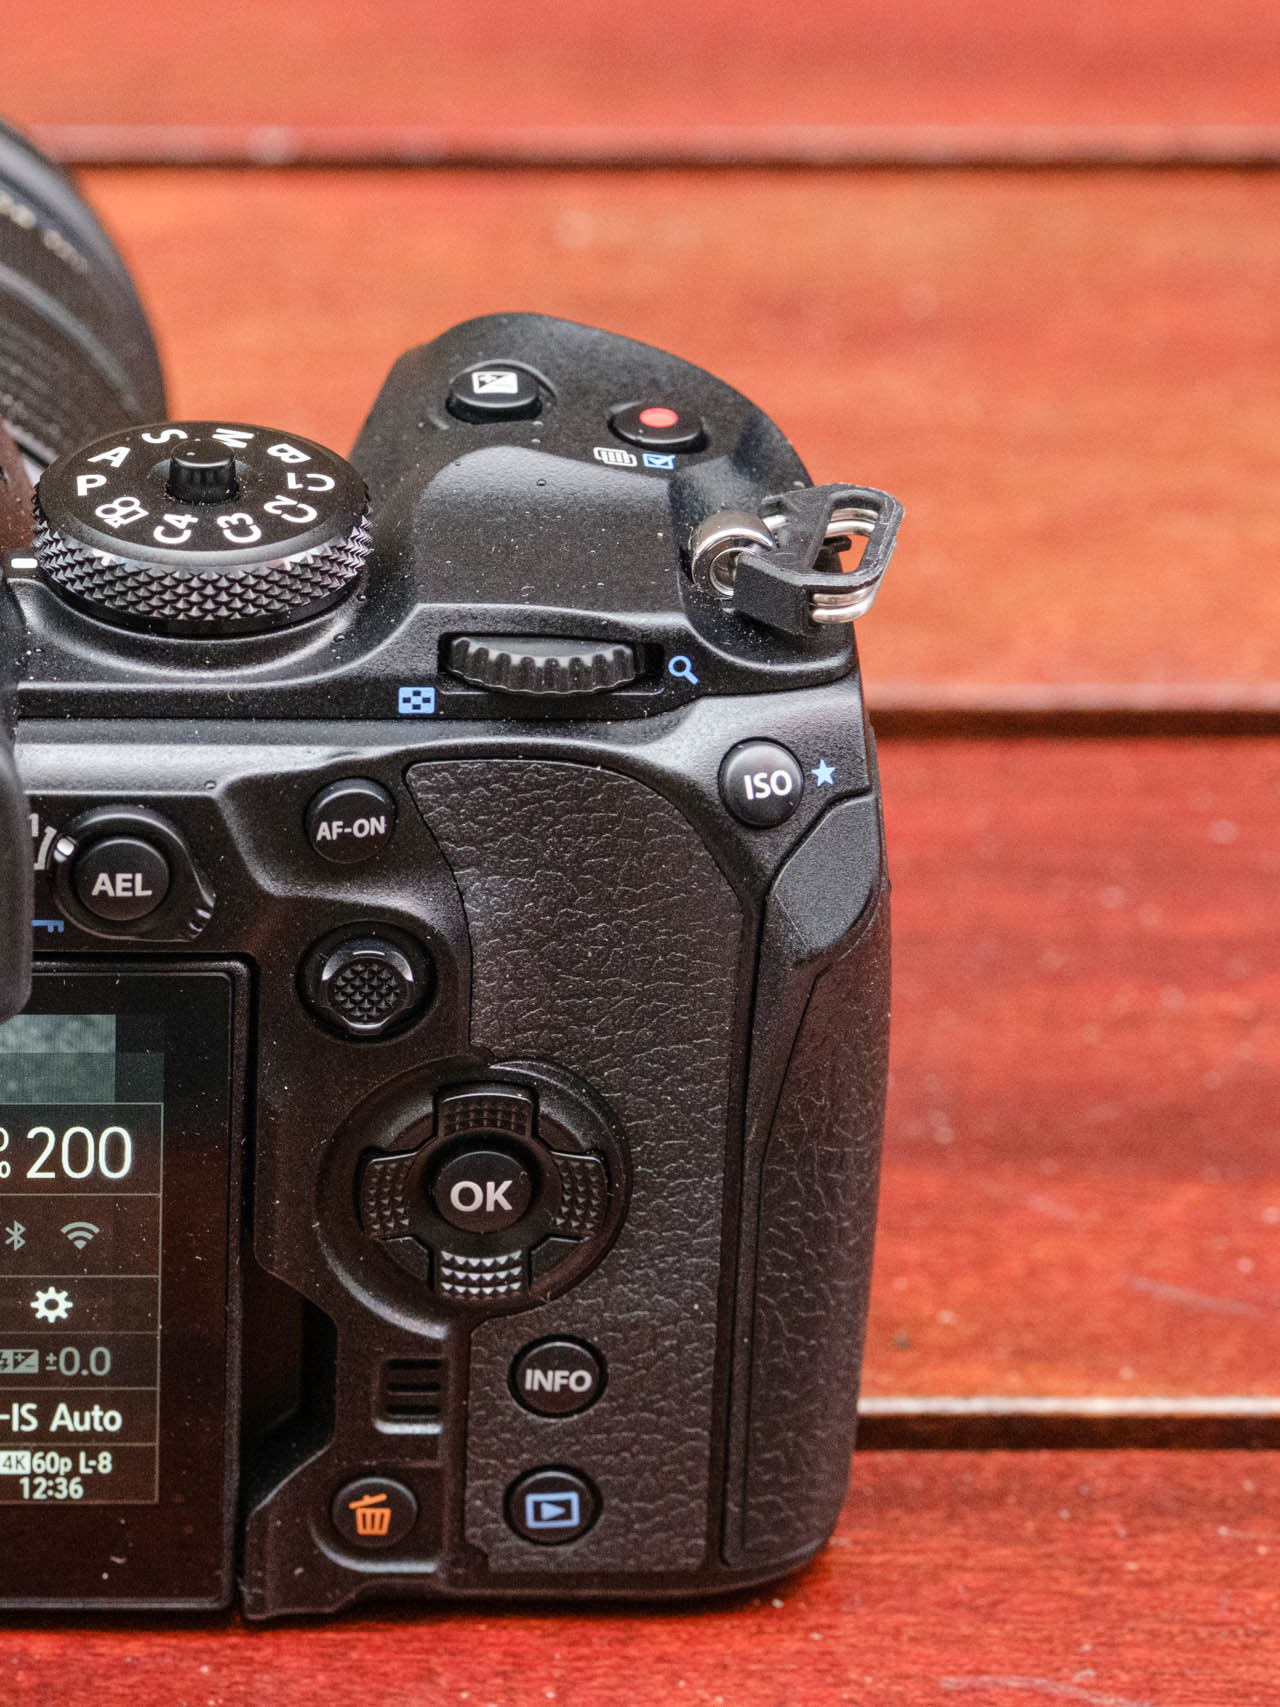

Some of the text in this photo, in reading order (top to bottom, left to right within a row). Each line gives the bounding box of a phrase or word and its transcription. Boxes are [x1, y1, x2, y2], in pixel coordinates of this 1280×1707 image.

[141, 428, 188, 444] S
[88, 446, 131, 468] A
[267, 443, 311, 464] B
[76, 474, 107, 496] P
[286, 472, 335, 492] C1
[263, 495, 318, 523] C2
[153, 513, 199, 544] C4
[217, 512, 262, 544] C3
[744, 770, 793, 800] ISO
[317, 816, 386, 841] AF-ON
[91, 873, 152, 897] AEL
[26, 1126, 132, 1179] 200
[450, 1180, 513, 1212] OK
[524, 1369, 592, 1393] INFO
[50, 1404, 122, 1432] Auto
[80, 1450, 112, 1473] L-8
[20, 1477, 84, 1500] 12:36
